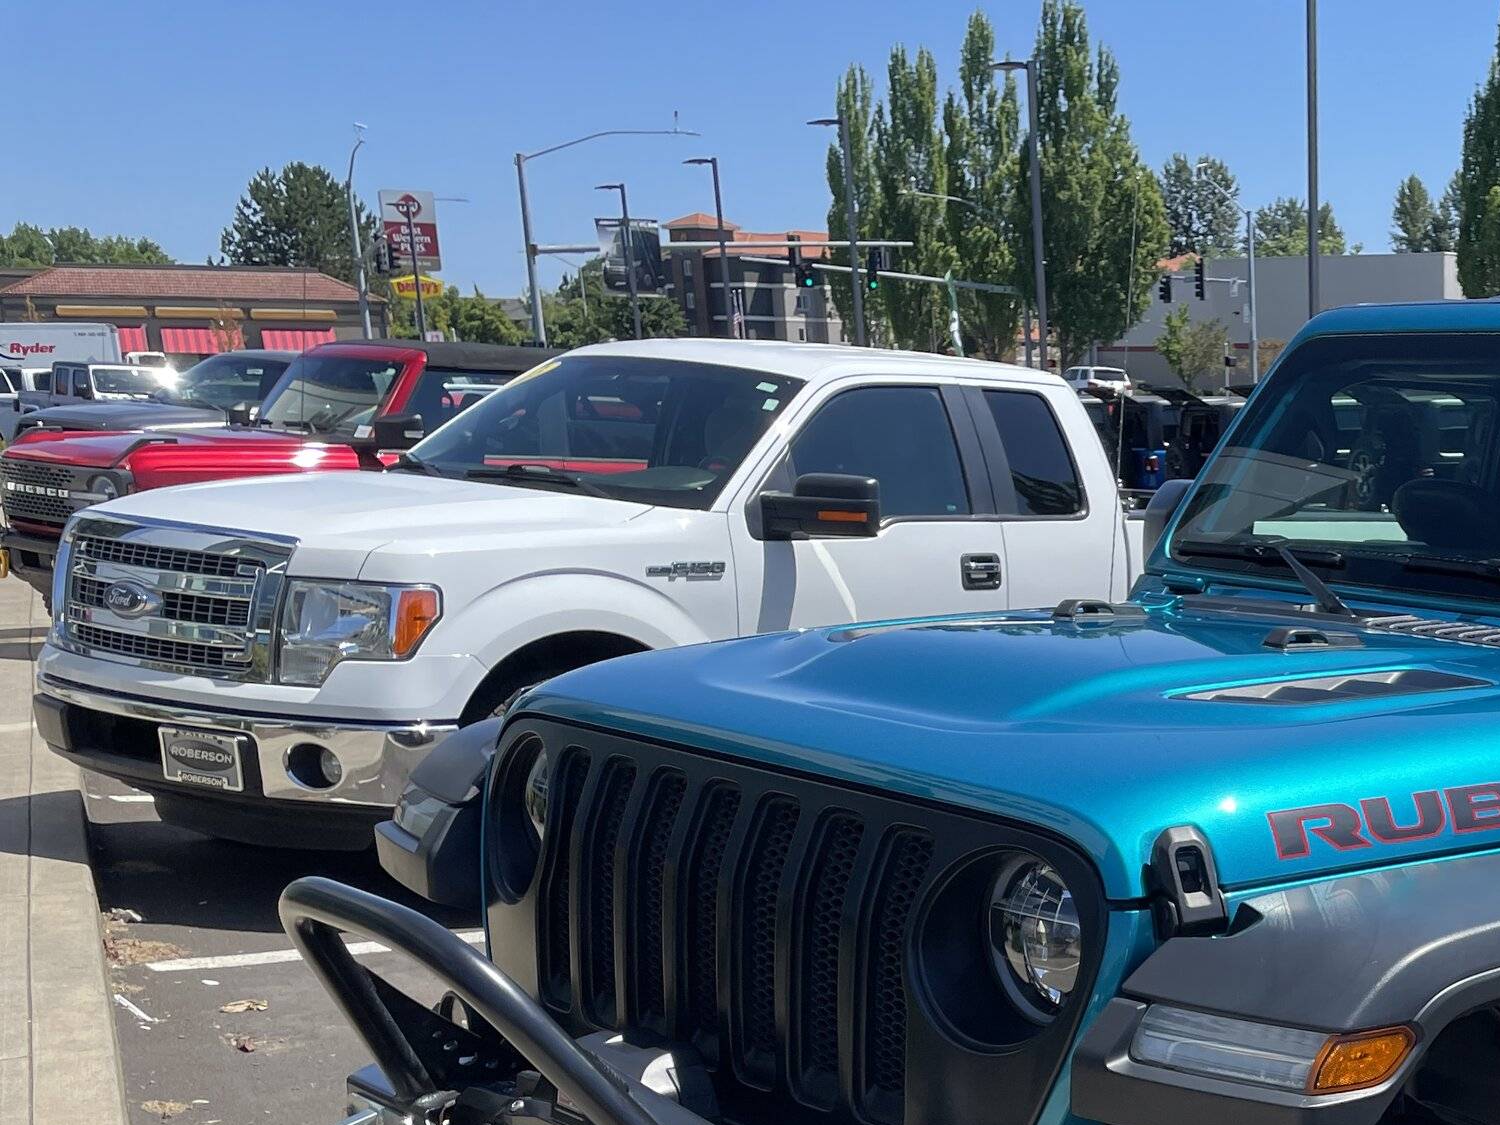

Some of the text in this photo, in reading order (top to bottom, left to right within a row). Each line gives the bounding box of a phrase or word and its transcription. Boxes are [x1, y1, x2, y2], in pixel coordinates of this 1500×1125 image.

[9, 342, 56, 356] Ryder
[108, 587, 133, 607] Ford
[169, 745, 233, 765] ROBERSON
[181, 773, 224, 787] ROBERSON
